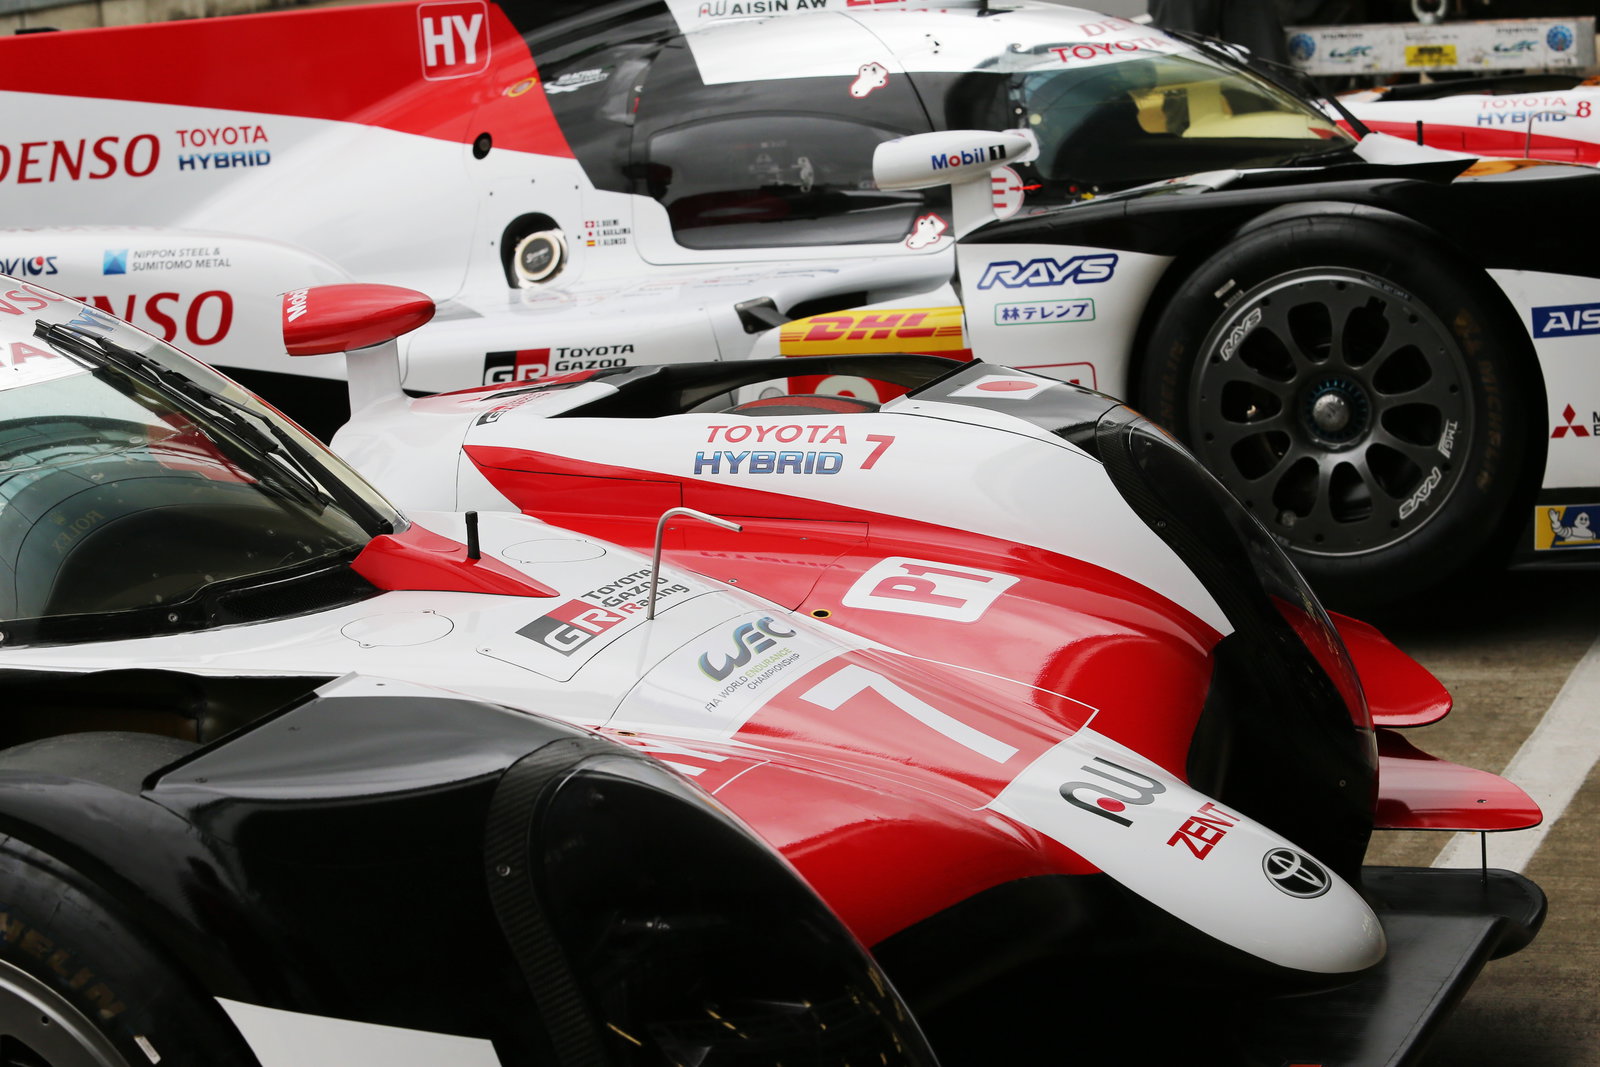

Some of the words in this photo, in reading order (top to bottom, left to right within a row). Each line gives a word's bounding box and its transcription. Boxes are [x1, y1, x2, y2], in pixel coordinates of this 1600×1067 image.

[731, 0, 789, 15] AISIN
[422, 13, 483, 67] HY
[1050, 37, 1169, 63] TOYOTA
[1481, 97, 1568, 110] TOYOTA
[1576, 100, 1592, 118] 8
[1477, 110, 1567, 126] HYBRID
[176, 126, 269, 148] TOYOTA
[178, 150, 272, 171] HYBRID
[931, 148, 985, 171] Mobil
[132, 258, 193, 272] SUMITOMO
[195, 257, 232, 268] METAL
[133, 249, 176, 259] NIPPON
[179, 248, 210, 257] STEEL
[213, 247, 221, 256] &
[977, 253, 1119, 290] RAYS
[1002, 302, 1090, 321] 林テレンプ
[1542, 309, 1600, 332] AIS
[803, 313, 936, 341] DHL
[1220, 307, 1262, 361] RAYS
[485, 363, 548, 387] GR
[556, 344, 635, 358] TOYOTA
[555, 358, 627, 372] GAZOO
[706, 425, 848, 445] TOYOTA
[693, 450, 844, 475] HYBRID
[859, 433, 896, 470] 7
[1399, 465, 1442, 521] RAYS
[581, 568, 653, 600] TOYOTA
[869, 562, 995, 609] P1
[543, 605, 623, 653] GR
[697, 616, 797, 683] WEC
[704, 696, 722, 713] FIA
[717, 675, 749, 701] WORLD
[744, 647, 792, 679] ENDURANCE
[747, 652, 801, 691] CHAMPIONSHIP
[799, 663, 1020, 764] 7
[1166, 801, 1241, 861] ZENT
